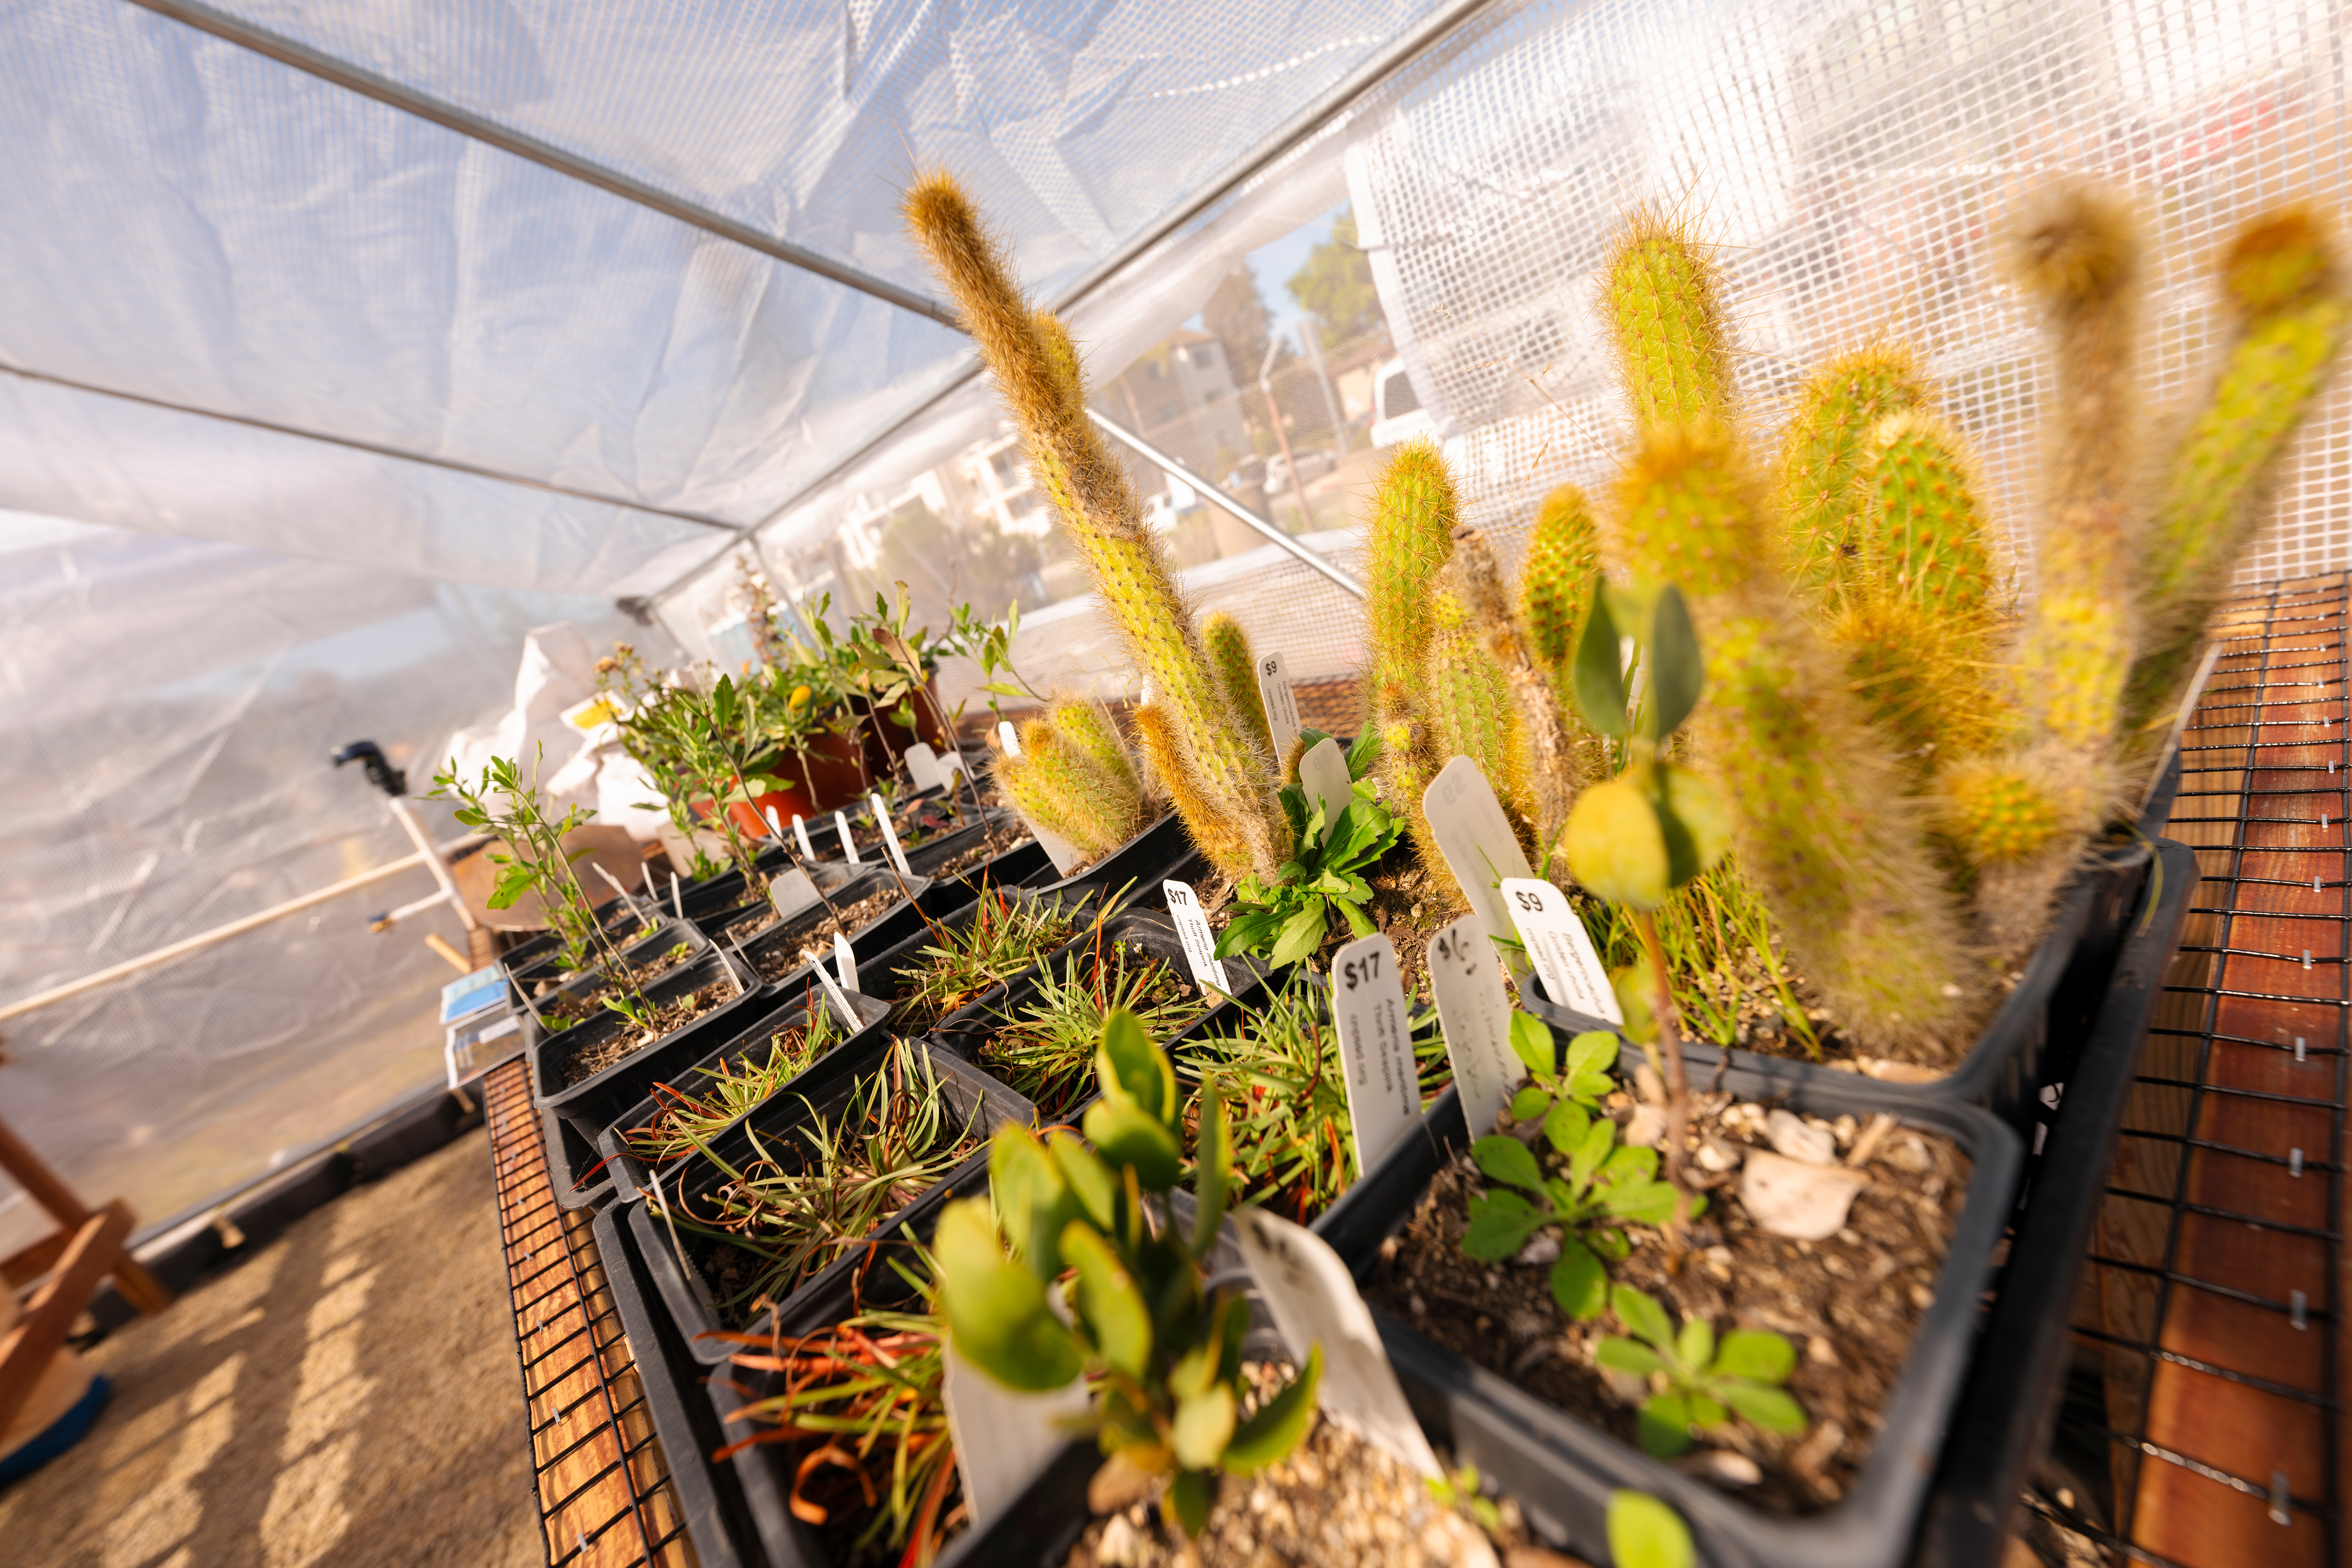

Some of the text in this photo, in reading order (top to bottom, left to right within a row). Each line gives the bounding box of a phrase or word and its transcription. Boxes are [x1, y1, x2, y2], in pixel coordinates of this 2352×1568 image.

[1265, 660, 1277, 677] $9
[1277, 683, 1285, 706] Golden
[1282, 681, 1296, 728] Bergerocactus
[1168, 887, 1187, 906] $17
[1515, 891, 1543, 913] $9
[1177, 915, 1193, 953] cnpssd.org
[1187, 918, 1208, 967] Thrift Seapink
[1194, 919, 1222, 986] Armeria maritima
[1344, 951, 1381, 992] $17
[1373, 1003, 1394, 1094] Thrift Seapink
[1385, 997, 1412, 1116] Armeria maritima
